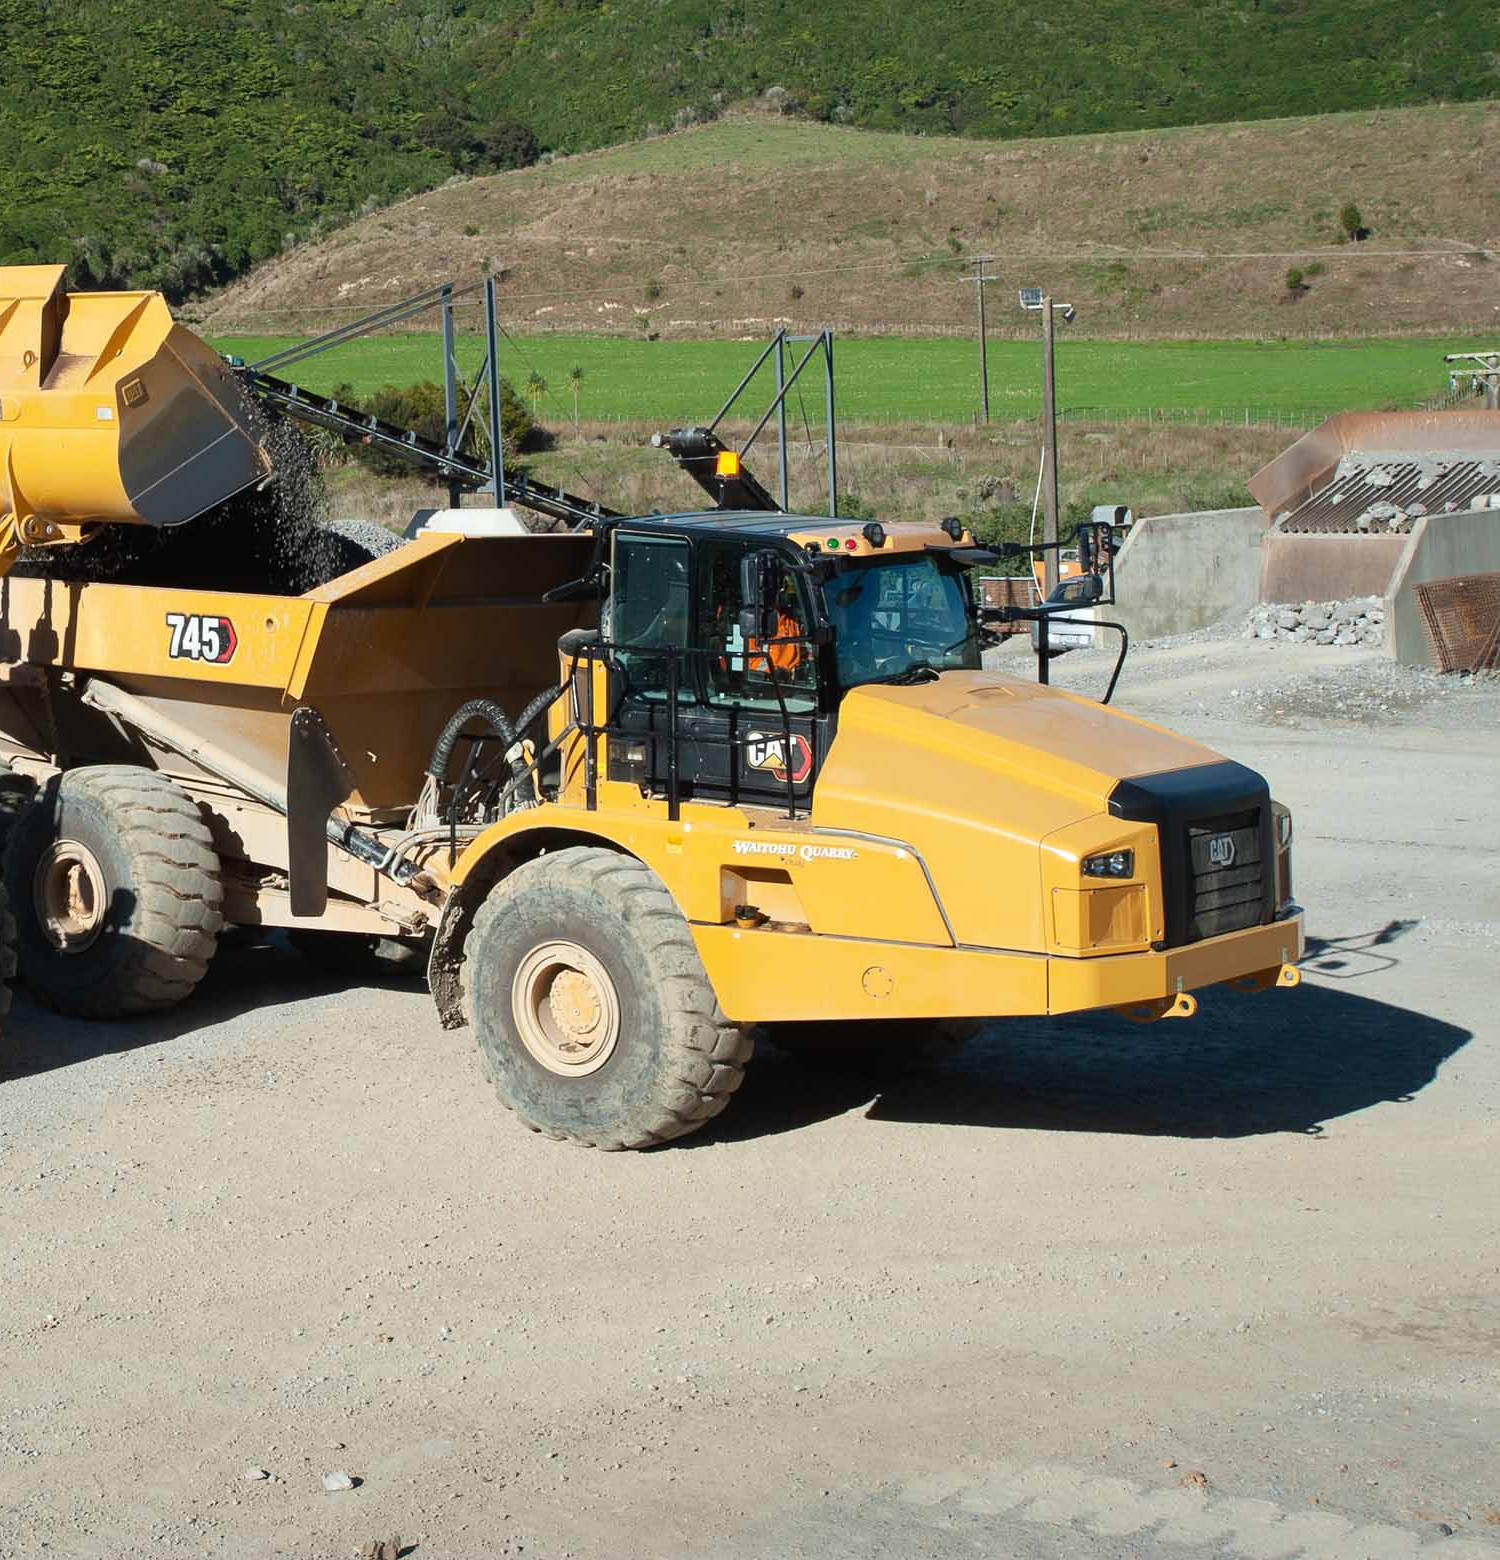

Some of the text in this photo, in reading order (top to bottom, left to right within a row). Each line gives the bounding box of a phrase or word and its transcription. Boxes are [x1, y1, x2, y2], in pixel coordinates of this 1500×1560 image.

[166, 614, 220, 661] 745
[733, 841, 854, 861] WAITOHU QUARRY
[1210, 836, 1228, 862] CAT
